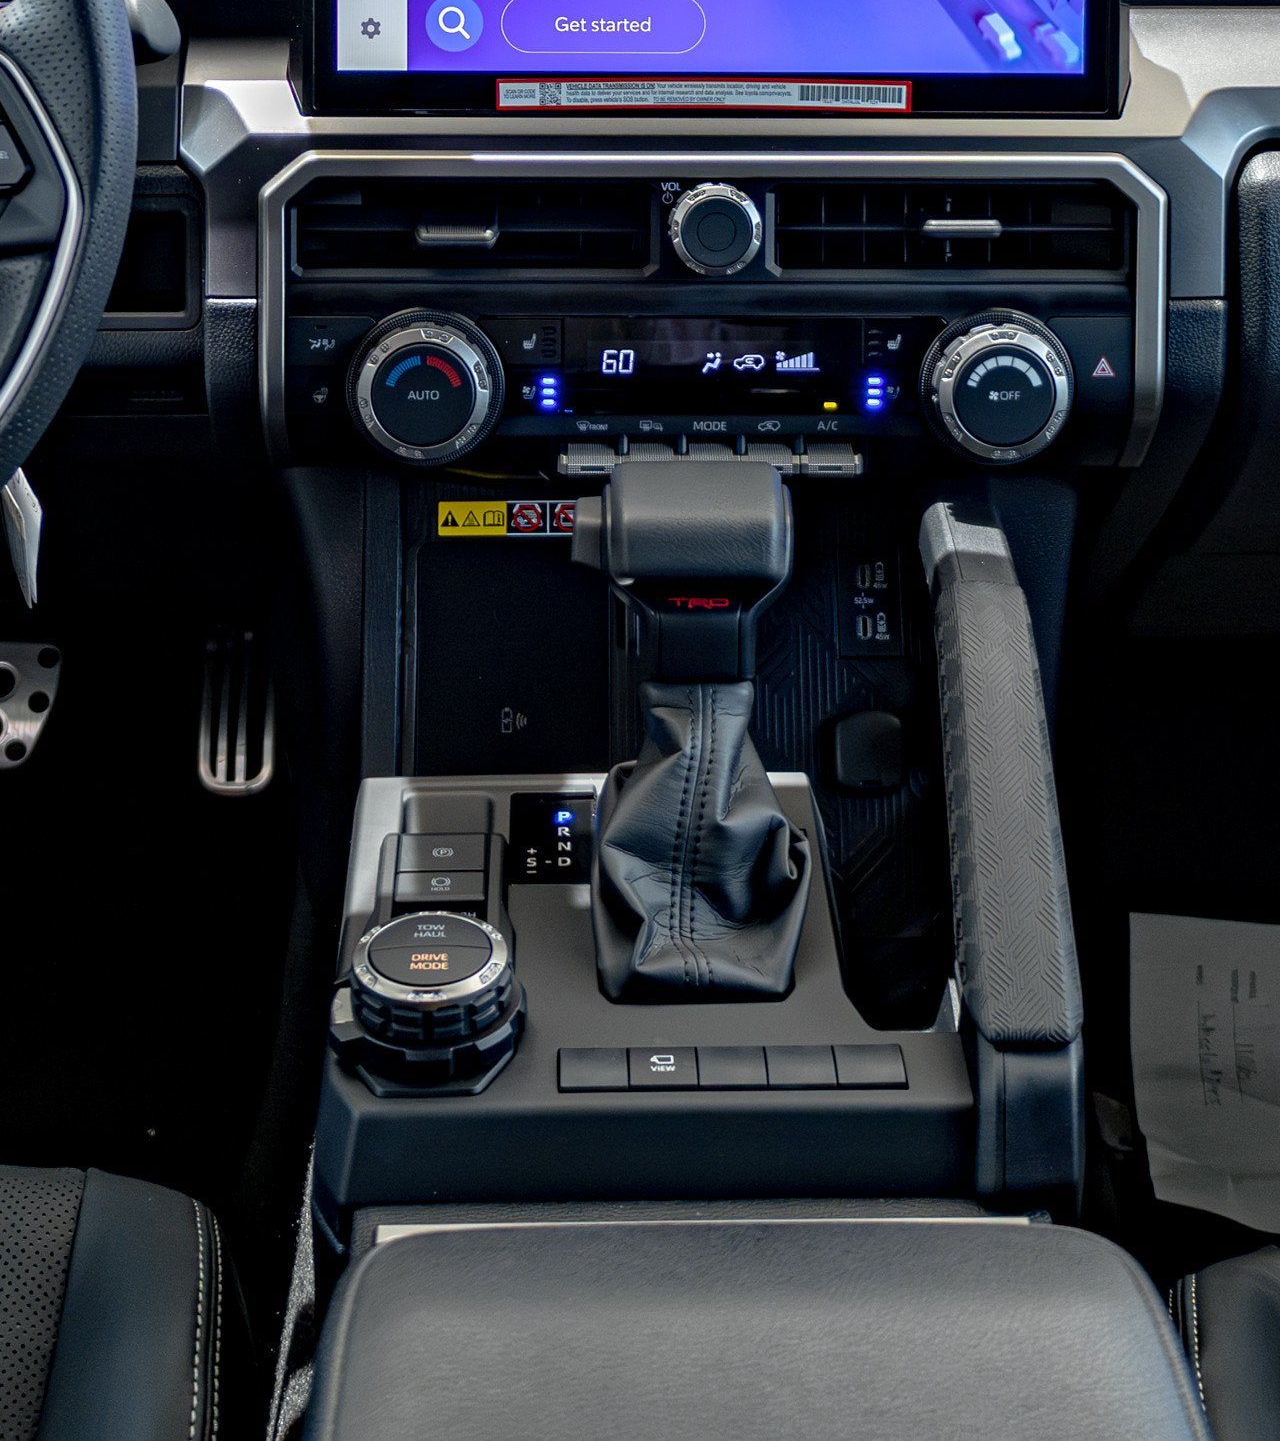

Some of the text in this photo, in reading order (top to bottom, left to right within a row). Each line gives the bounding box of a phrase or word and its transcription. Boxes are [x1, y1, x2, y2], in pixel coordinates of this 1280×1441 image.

[555, 17, 651, 32] Get started
[661, 182, 681, 191] VOL
[602, 349, 634, 374] 60
[408, 390, 439, 400] AUTO
[1000, 391, 1020, 400] OFF
[693, 421, 727, 431] MODE
[817, 420, 838, 431] A/C
[668, 598, 729, 609] TRD
[558, 812, 571, 821] P
[558, 827, 571, 836] R
[558, 842, 571, 851] N
[527, 857, 571, 867] S D
[412, 953, 448, 961] DRIVE
[409, 962, 449, 970] MODE
